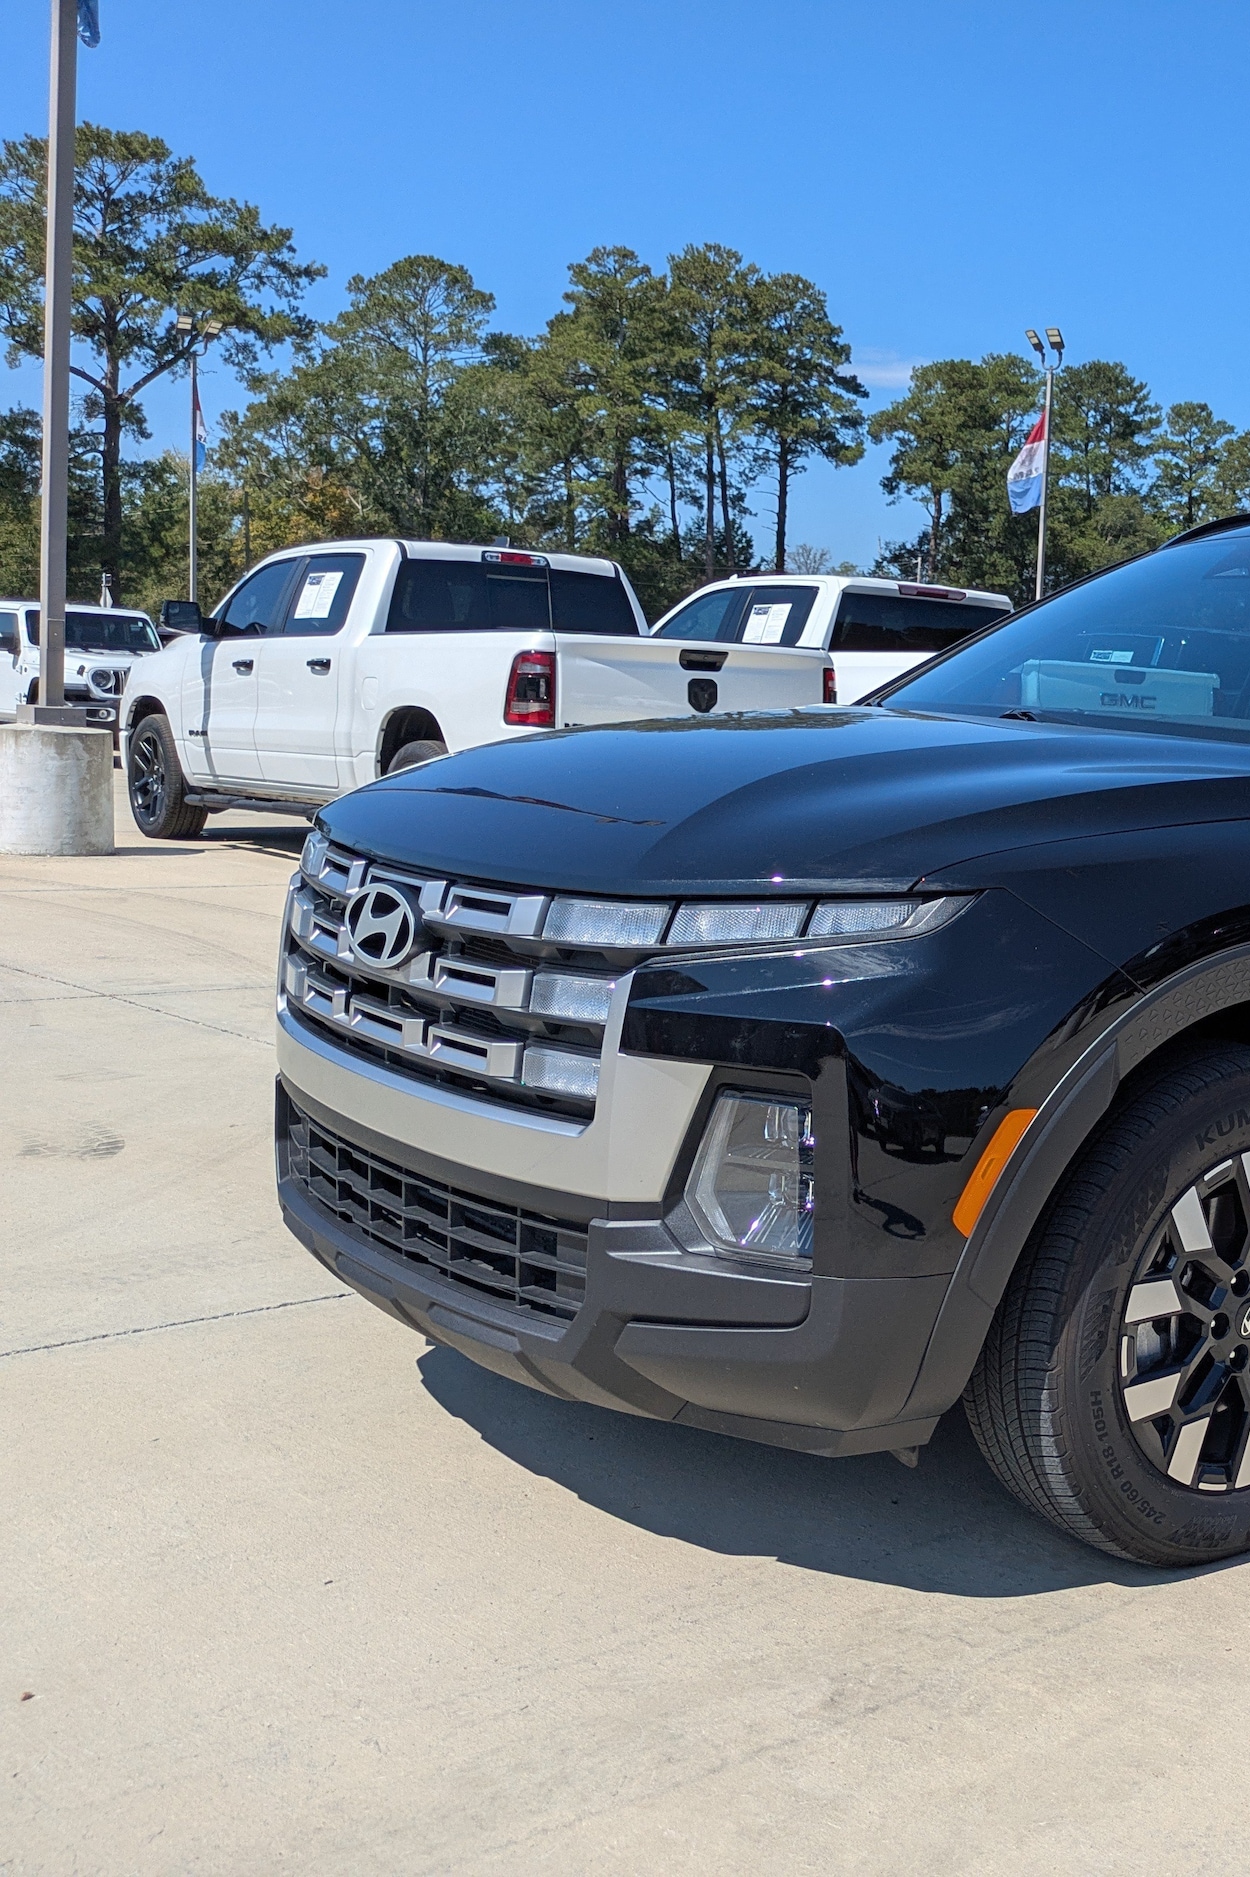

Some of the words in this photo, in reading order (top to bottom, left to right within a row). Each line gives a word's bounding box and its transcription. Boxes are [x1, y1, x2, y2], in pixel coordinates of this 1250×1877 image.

[1100, 692, 1157, 709] GMC
[1089, 1390, 1109, 1442] 105H
[1102, 1445, 1125, 1480] R18
[1120, 1480, 1167, 1525] 245/60
